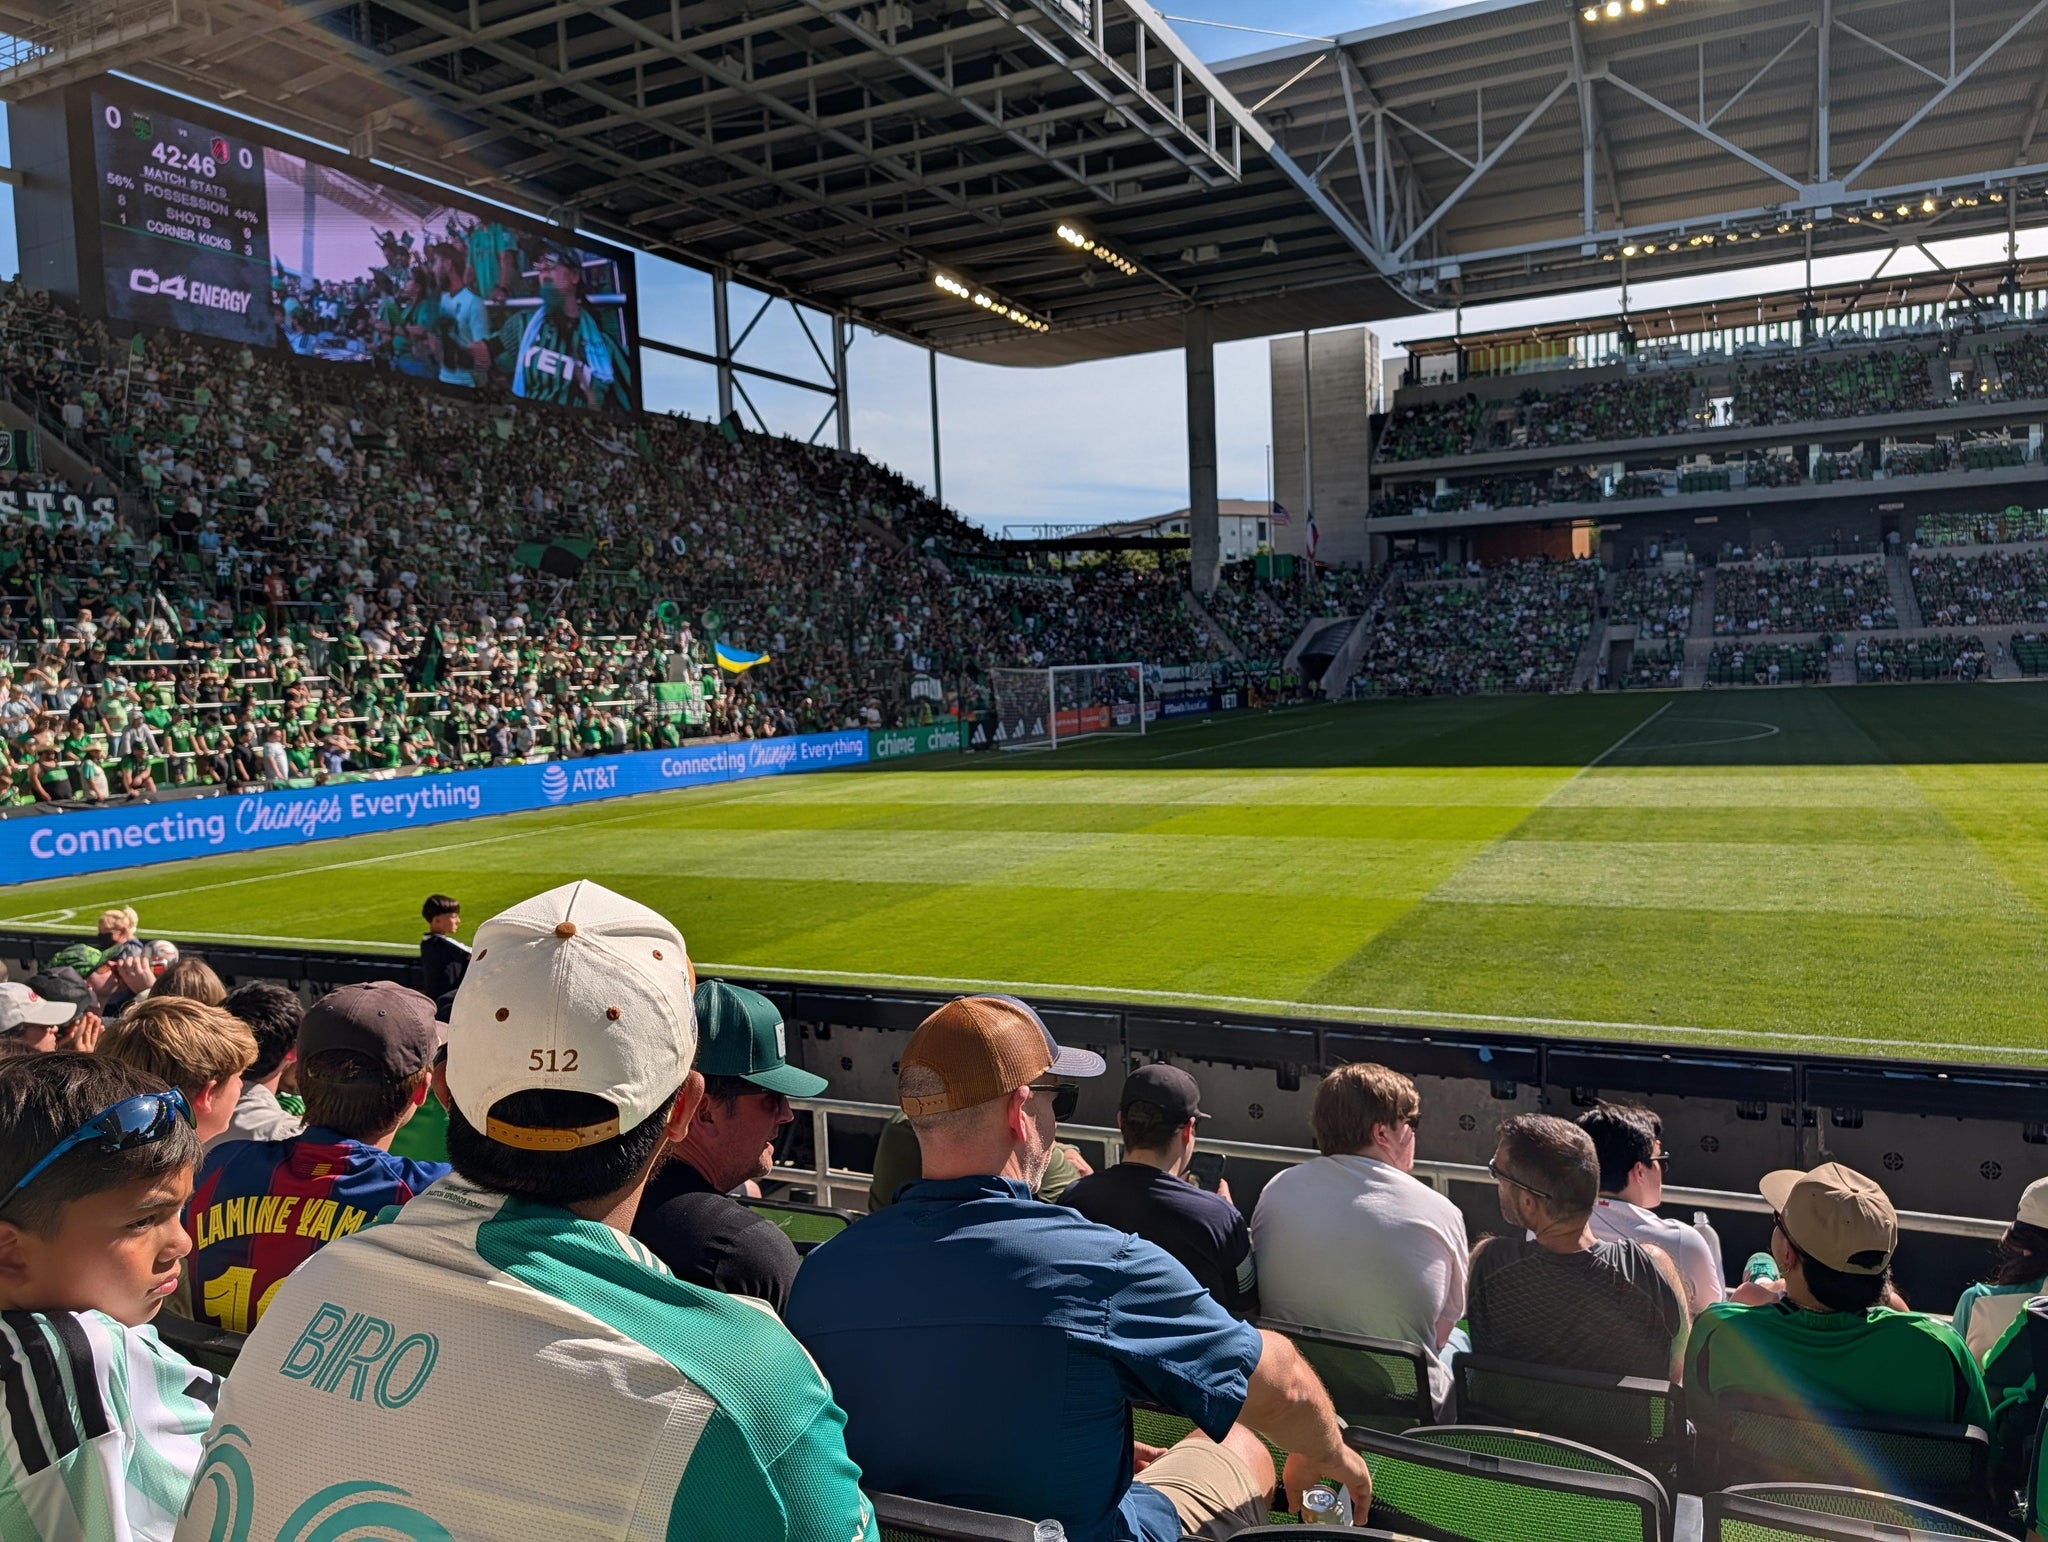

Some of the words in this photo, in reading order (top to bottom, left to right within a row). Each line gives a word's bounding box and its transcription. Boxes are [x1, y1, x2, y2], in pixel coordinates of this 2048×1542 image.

[105, 105, 122, 129] 0
[152, 142, 216, 178] 42:46
[239, 148, 253, 169] 0
[143, 165, 187, 187] MATCH
[190, 179, 227, 198] STATS
[144, 182, 229, 216] POSSESSION
[166, 207, 211, 229] SHOTS
[146, 219, 196, 242] CORNER
[198, 232, 232, 250] KICKS
[129, 267, 188, 300] C4
[189, 281, 252, 314] ENERGY
[876, 732, 915, 757] chime
[927, 727, 960, 750] chime
[661, 750, 746, 778] Connecting
[748, 739, 798, 771] Changes
[800, 732, 864, 761] Everything
[572, 764, 619, 793] AT&T
[29, 812, 226, 859] Connecting
[236, 793, 342, 838] Changes
[350, 782, 481, 821] Everything
[528, 1049, 578, 1072] 512
[196, 1196, 300, 1250] LAMINE
[296, 1198, 378, 1242] YAM
[279, 1301, 440, 1410] BIRO
